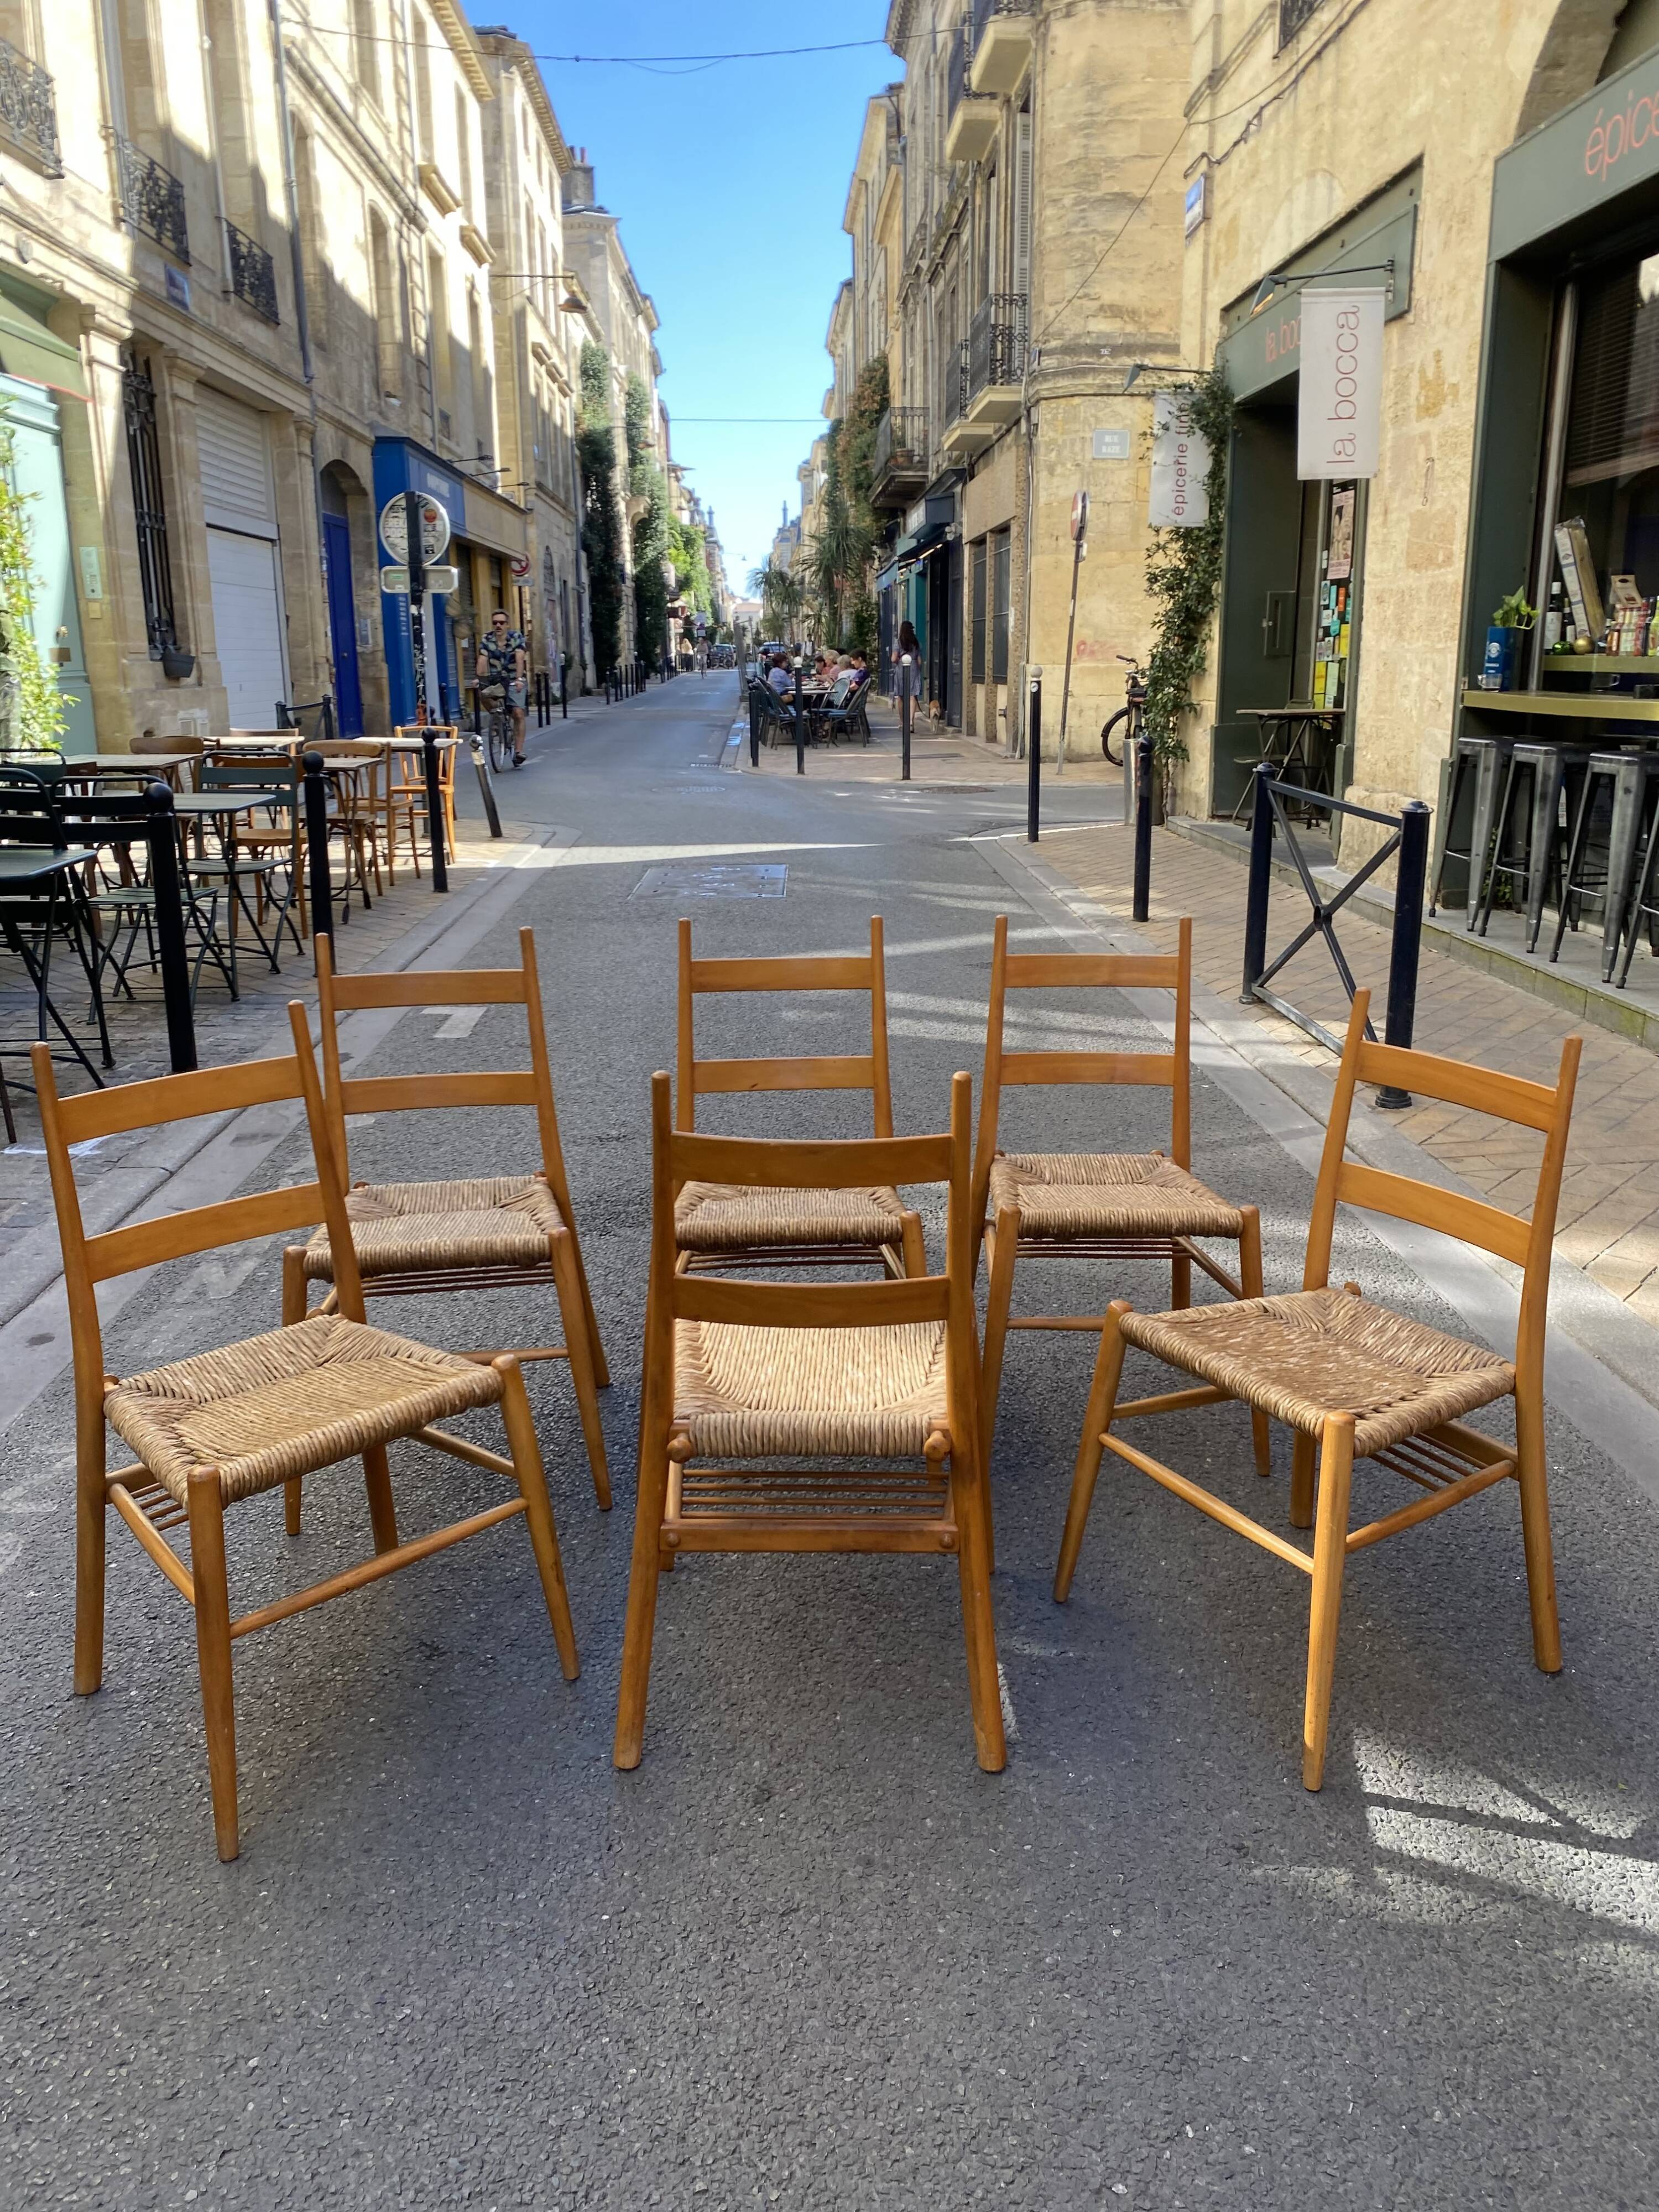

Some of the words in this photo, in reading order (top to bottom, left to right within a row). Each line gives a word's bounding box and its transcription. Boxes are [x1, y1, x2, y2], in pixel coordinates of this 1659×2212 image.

[1265, 327, 1277, 363] la
[1327, 305, 1360, 420] bocca
[1326, 432, 1357, 463] la
[1172, 444, 1188, 515] épicerie
